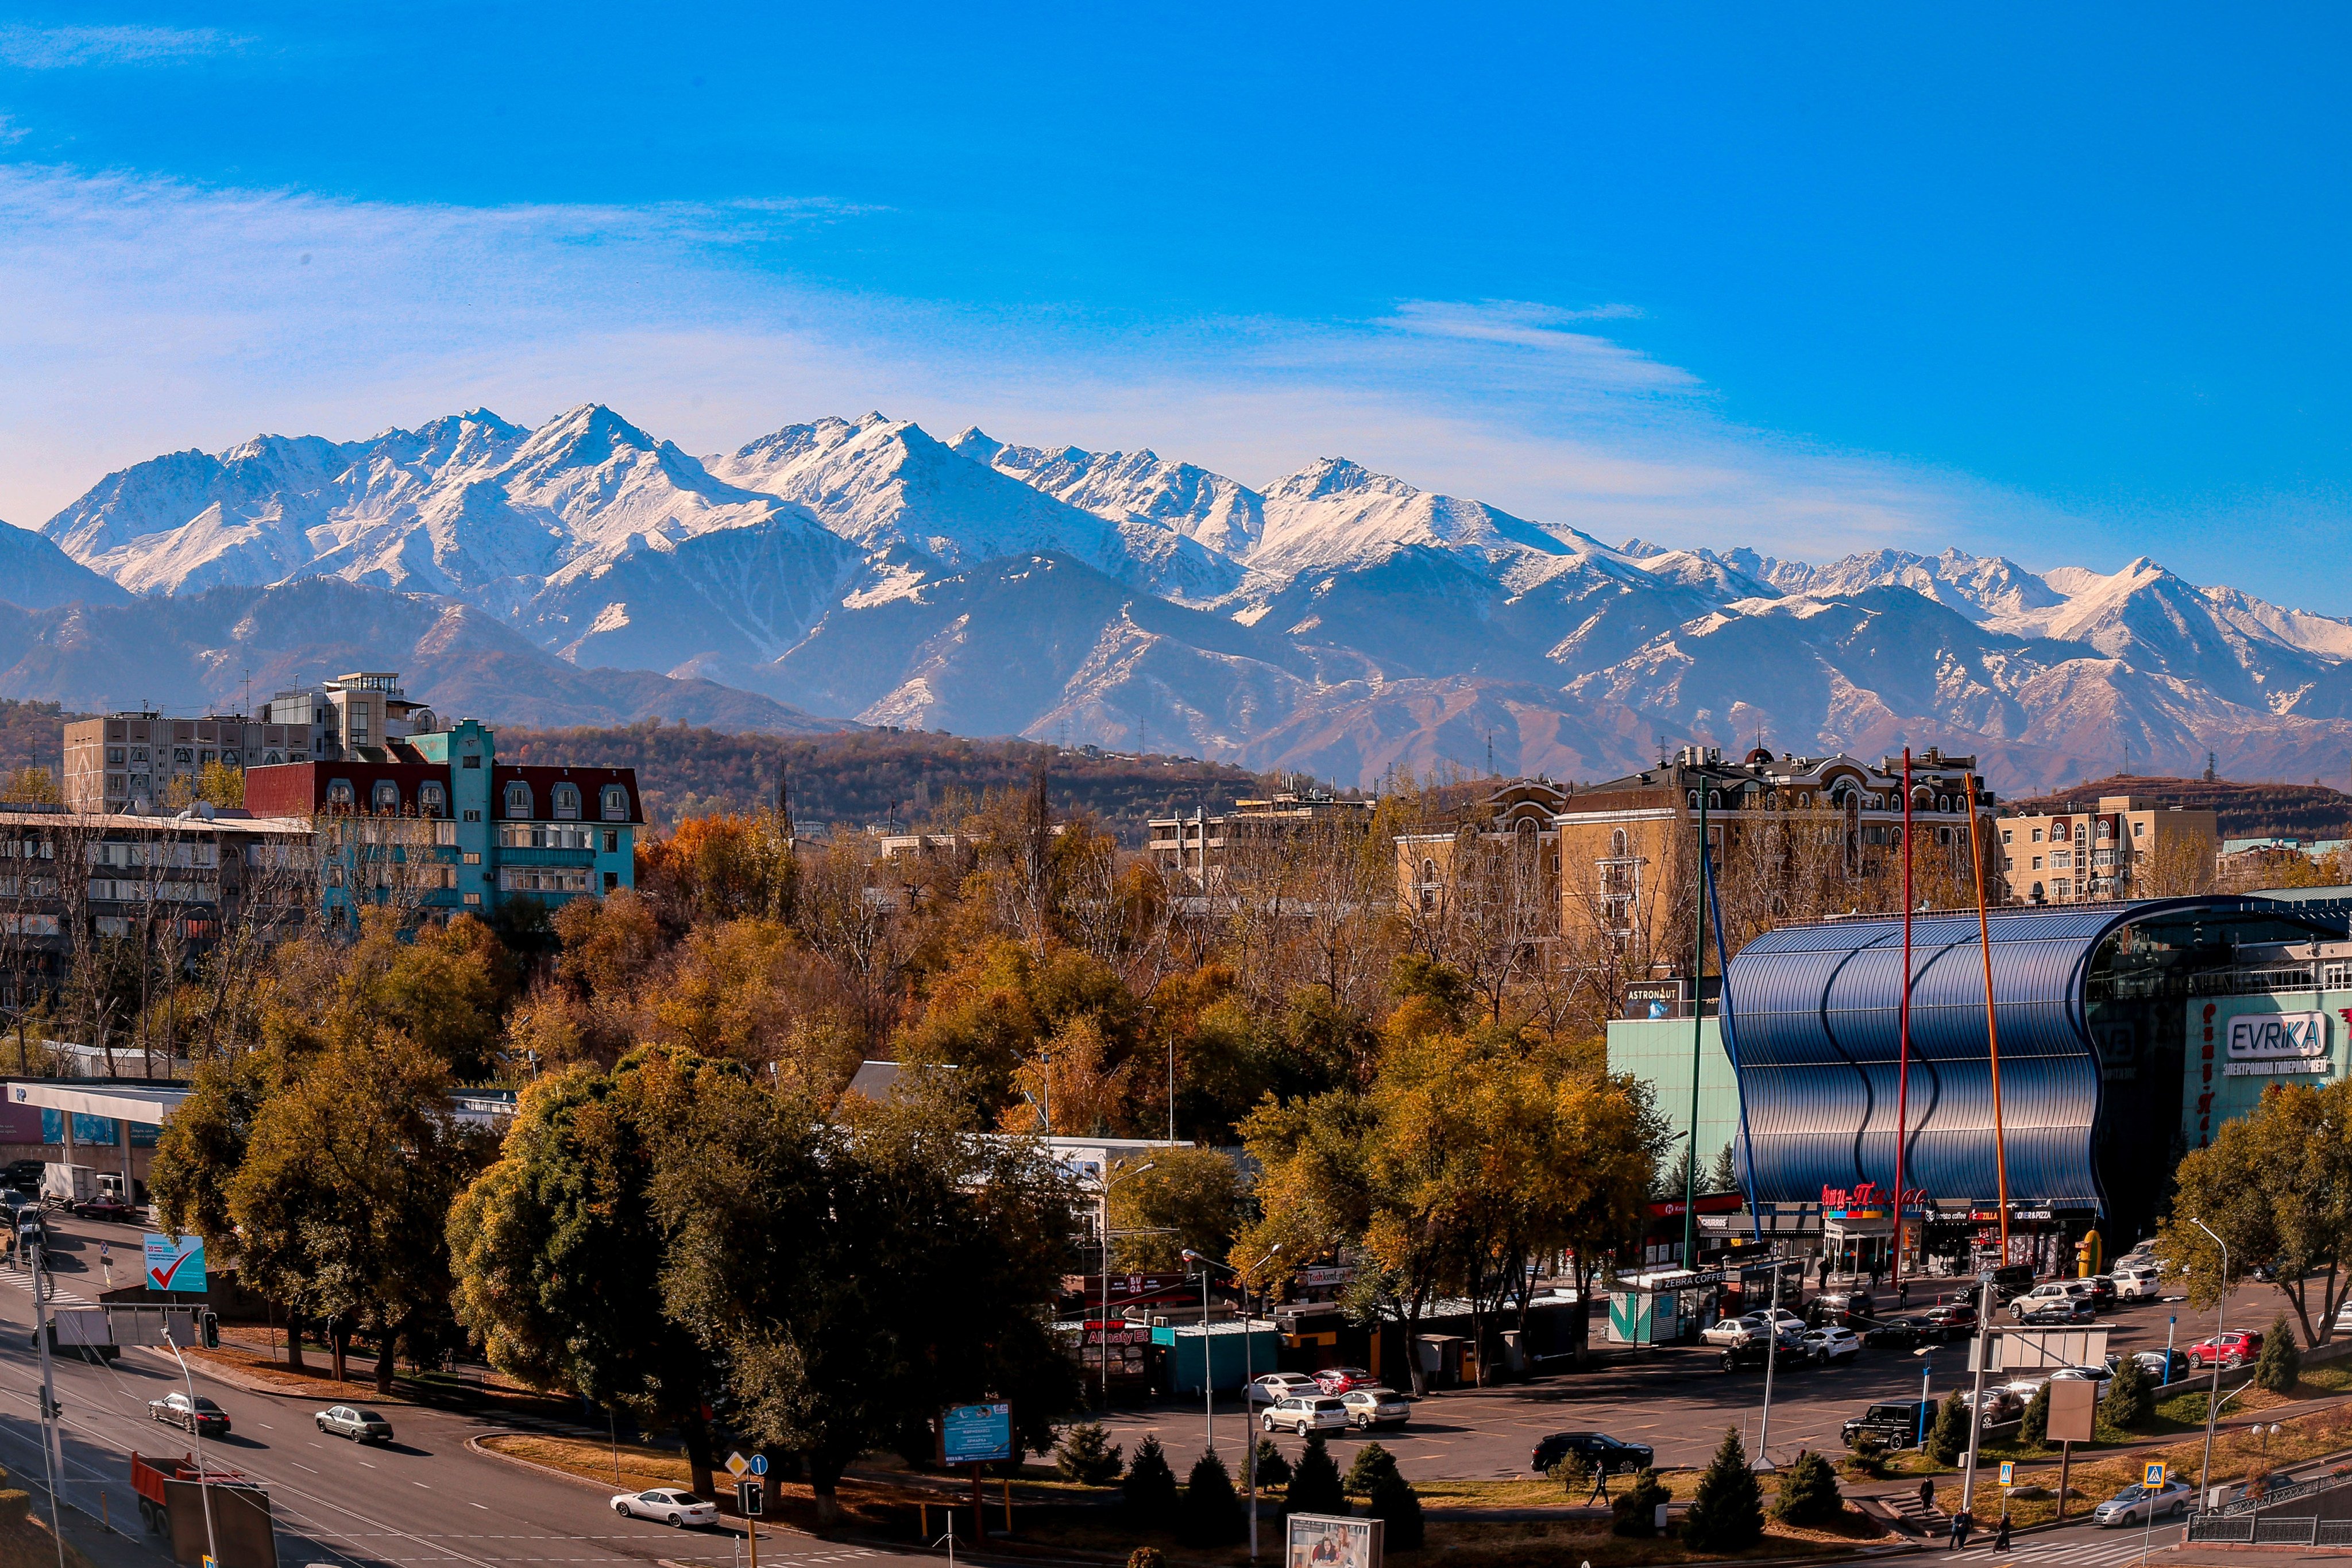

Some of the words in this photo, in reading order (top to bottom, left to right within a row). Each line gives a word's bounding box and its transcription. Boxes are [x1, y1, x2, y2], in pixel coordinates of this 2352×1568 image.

[1628, 987, 1675, 1000] ASTRONAUT
[2223, 1061, 2273, 1076] ЭЛЕКТРОНИКА
[1952, 1211, 1967, 1219] coffee
[1702, 1219, 1726, 1227] CHURROS
[1309, 1270, 1337, 1282] Toshkent
[1665, 1276, 1693, 1288] ZEBRA
[1695, 1272, 1726, 1284] COFFEE
[1134, 1330, 1148, 1342] Et
